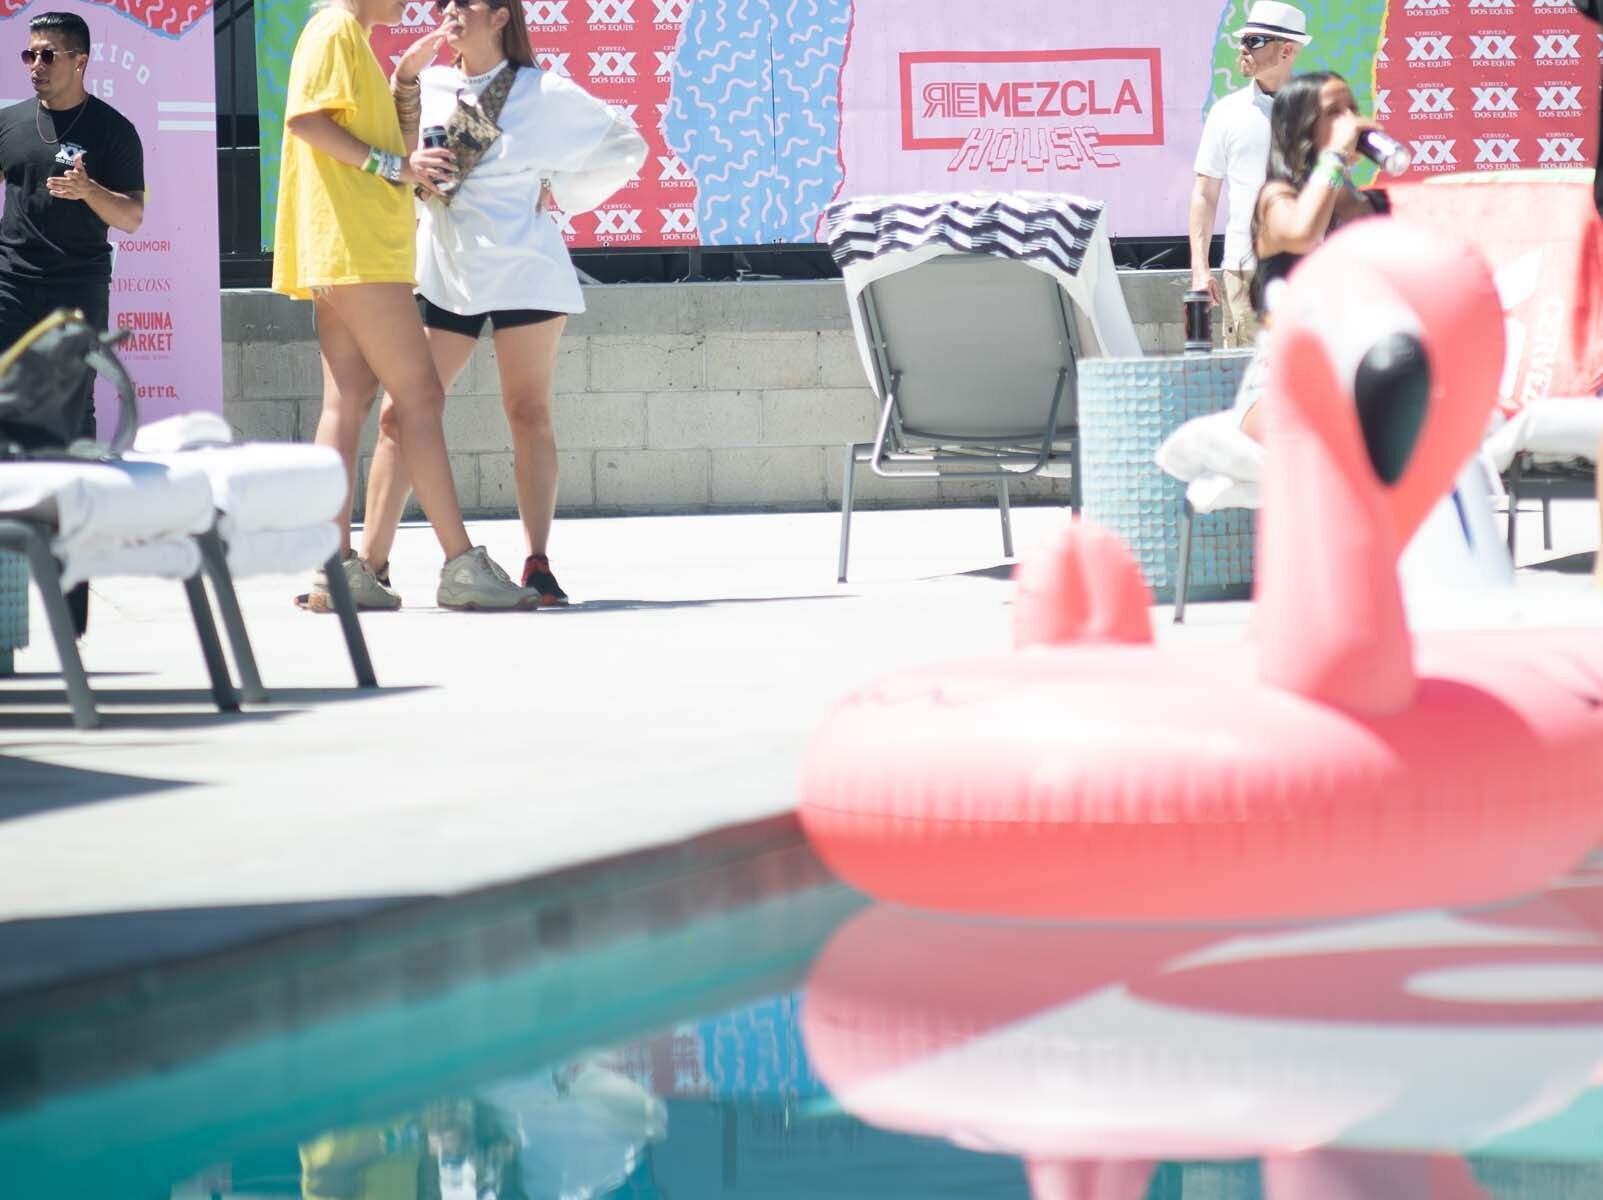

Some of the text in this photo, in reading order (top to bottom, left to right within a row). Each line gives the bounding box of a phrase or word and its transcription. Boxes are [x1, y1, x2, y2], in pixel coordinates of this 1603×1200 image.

[520, 0, 569, 24] XX
[585, 0, 636, 24] XX
[1425, 8, 1450, 16] EQUIS
[1535, 7, 1578, 15] DOS EQUIS
[1404, 35, 1453, 61] XX
[1468, 35, 1518, 59] XX
[1533, 34, 1582, 59] XX
[91, 43, 150, 85] XICO
[587, 52, 637, 76] XX
[1427, 60, 1452, 68] EQUIS
[1491, 60, 1516, 68] EQUIS
[610, 76, 636, 84] EQUIS
[922, 79, 1143, 118] REMEZCLA
[1407, 87, 1456, 113] XX
[1470, 87, 1520, 111] XX
[1534, 86, 1583, 110] XX
[1430, 112, 1454, 120] EQUIS
[946, 126, 1121, 173] HOUSE
[1408, 140, 1458, 164] XX
[1472, 139, 1521, 162] XX
[1536, 137, 1585, 162] XX
[593, 209, 643, 234] XX
[118, 240, 171, 252] KOUMORI
[596, 234, 641, 242] DOS EQUIS
[681, 234, 699, 242] EQU
[117, 311, 173, 330] GENUINA
[117, 333, 173, 351] MARKET
[116, 381, 180, 400] orra
